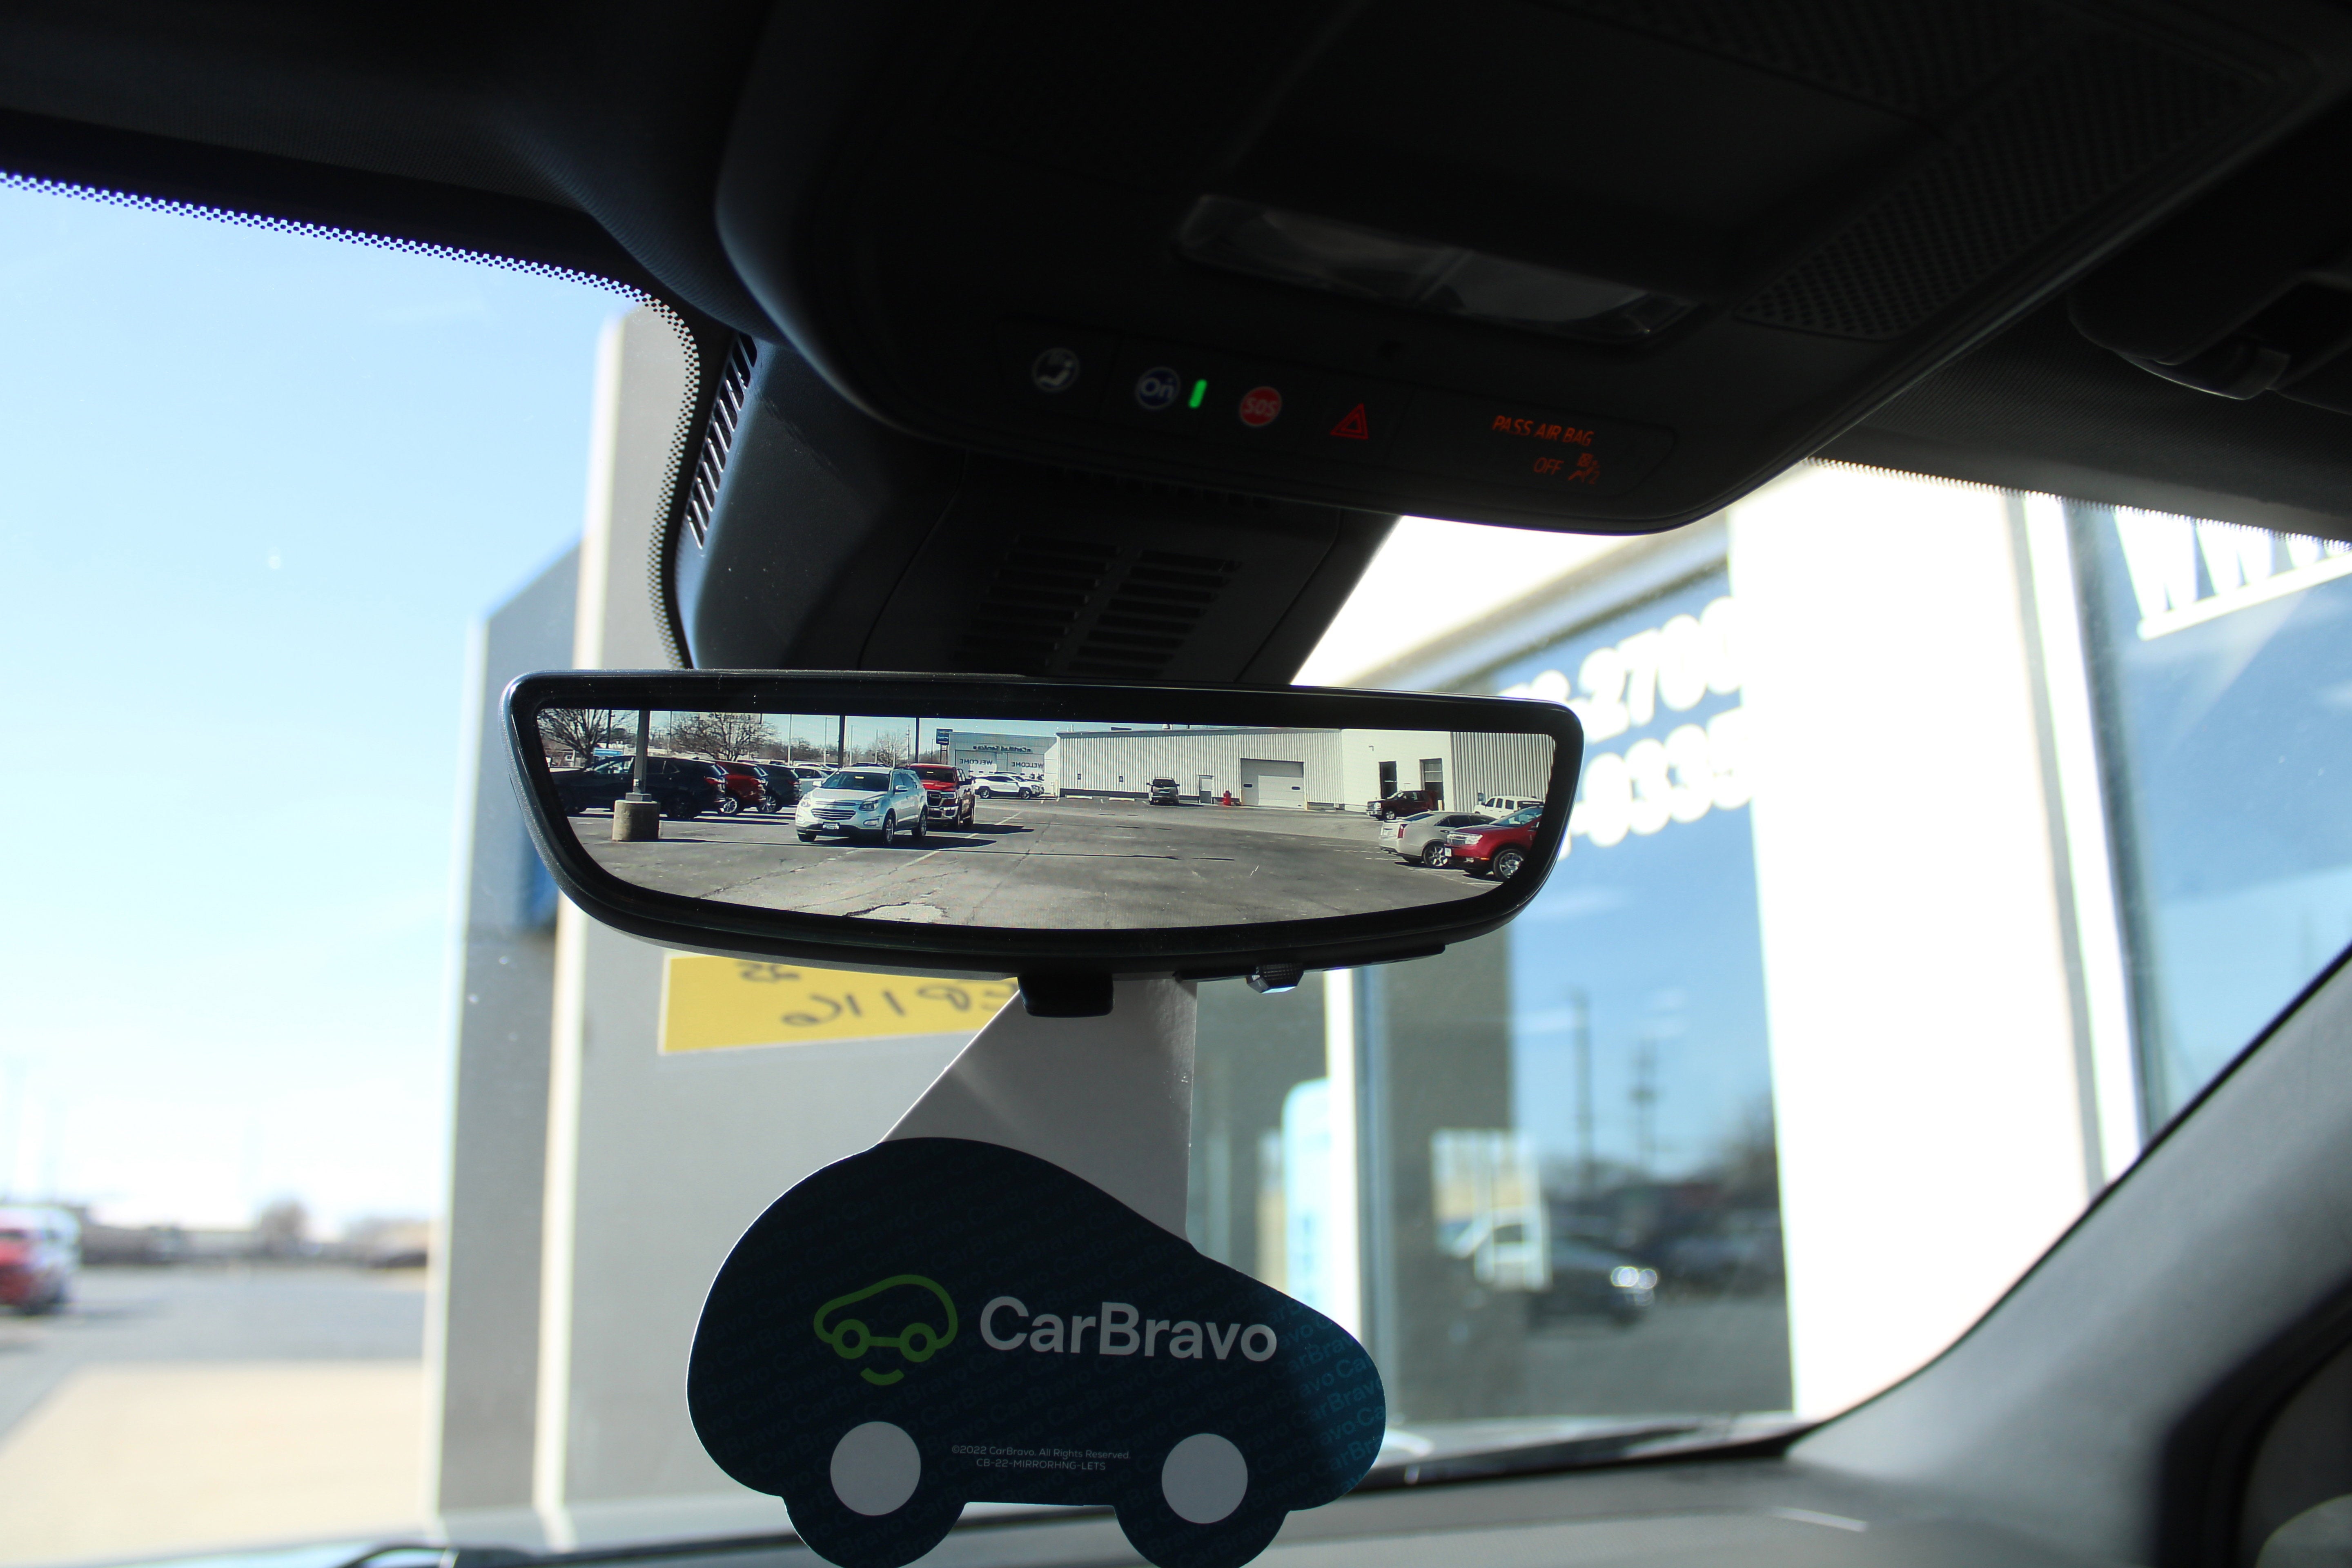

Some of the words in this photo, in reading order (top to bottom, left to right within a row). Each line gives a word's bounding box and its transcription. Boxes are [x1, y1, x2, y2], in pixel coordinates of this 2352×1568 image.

[1245, 396, 1279, 417] SOS
[1492, 414, 1534, 436] PASS
[1533, 423, 1562, 441] AIR
[1561, 427, 1595, 447] BAG
[1533, 457, 1565, 475] OFF
[980, 1296, 1277, 1362] CarBravo
[952, 1445, 987, 1454] ©2022
[989, 1446, 1036, 1456] CarBravo.
[1039, 1448, 1051, 1456] All
[1054, 1448, 1083, 1460] Rights
[1086, 1450, 1131, 1459] Reserved.
[976, 1458, 1106, 1470] CB-22-MIRRORHNG-LETS
